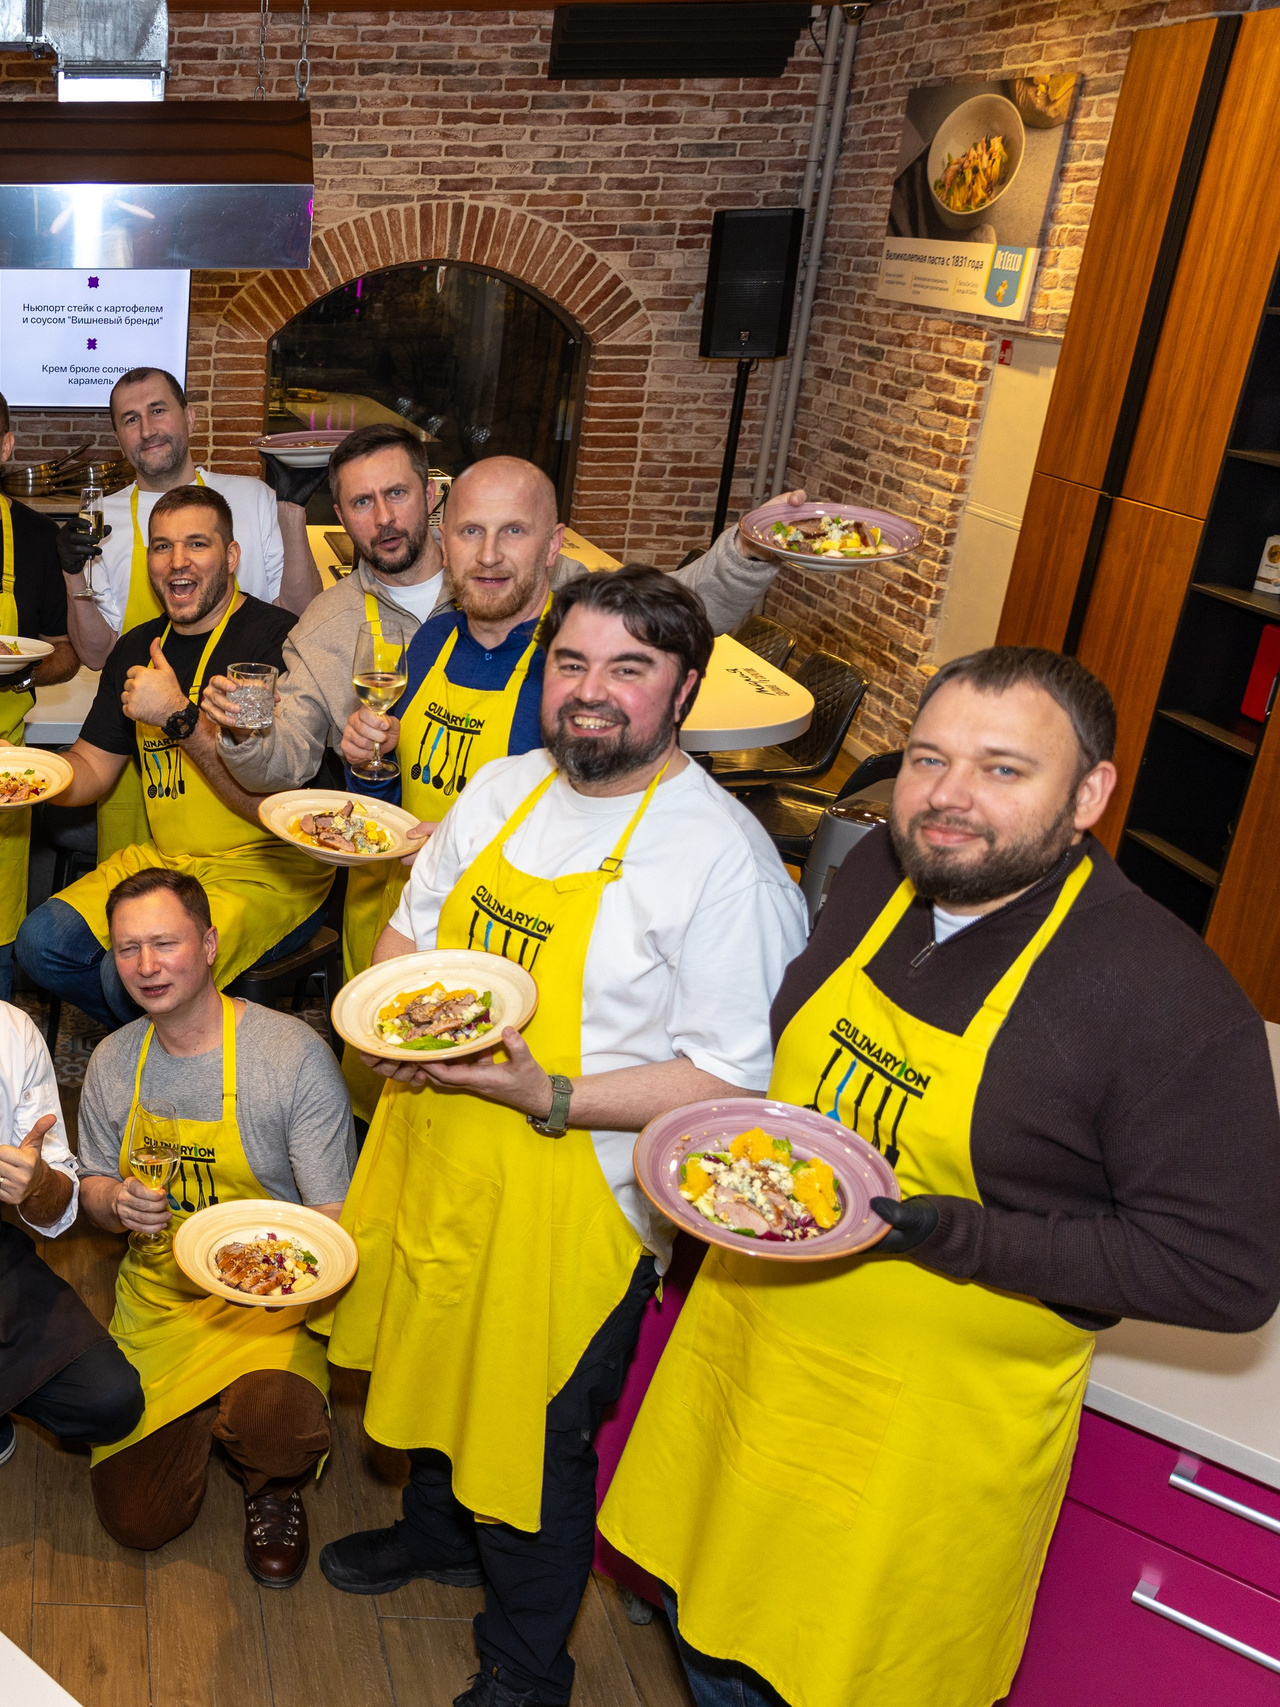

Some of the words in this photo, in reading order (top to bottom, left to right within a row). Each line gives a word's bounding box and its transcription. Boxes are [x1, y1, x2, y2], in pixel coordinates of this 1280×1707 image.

[927, 255, 945, 267] паста
[951, 255, 968, 268] 1831
[968, 258, 984, 271] года
[22, 303, 65, 313] Ньюпорт
[67, 304, 94, 313] стейк
[104, 304, 163, 314] картофелем
[30, 317, 66, 326] соусом
[67, 316, 122, 325] "Вишневый
[124, 316, 163, 326] бренди"
[42, 364, 68, 374] Крем
[69, 364, 100, 374] брюле
[68, 378, 114, 386] карамель
